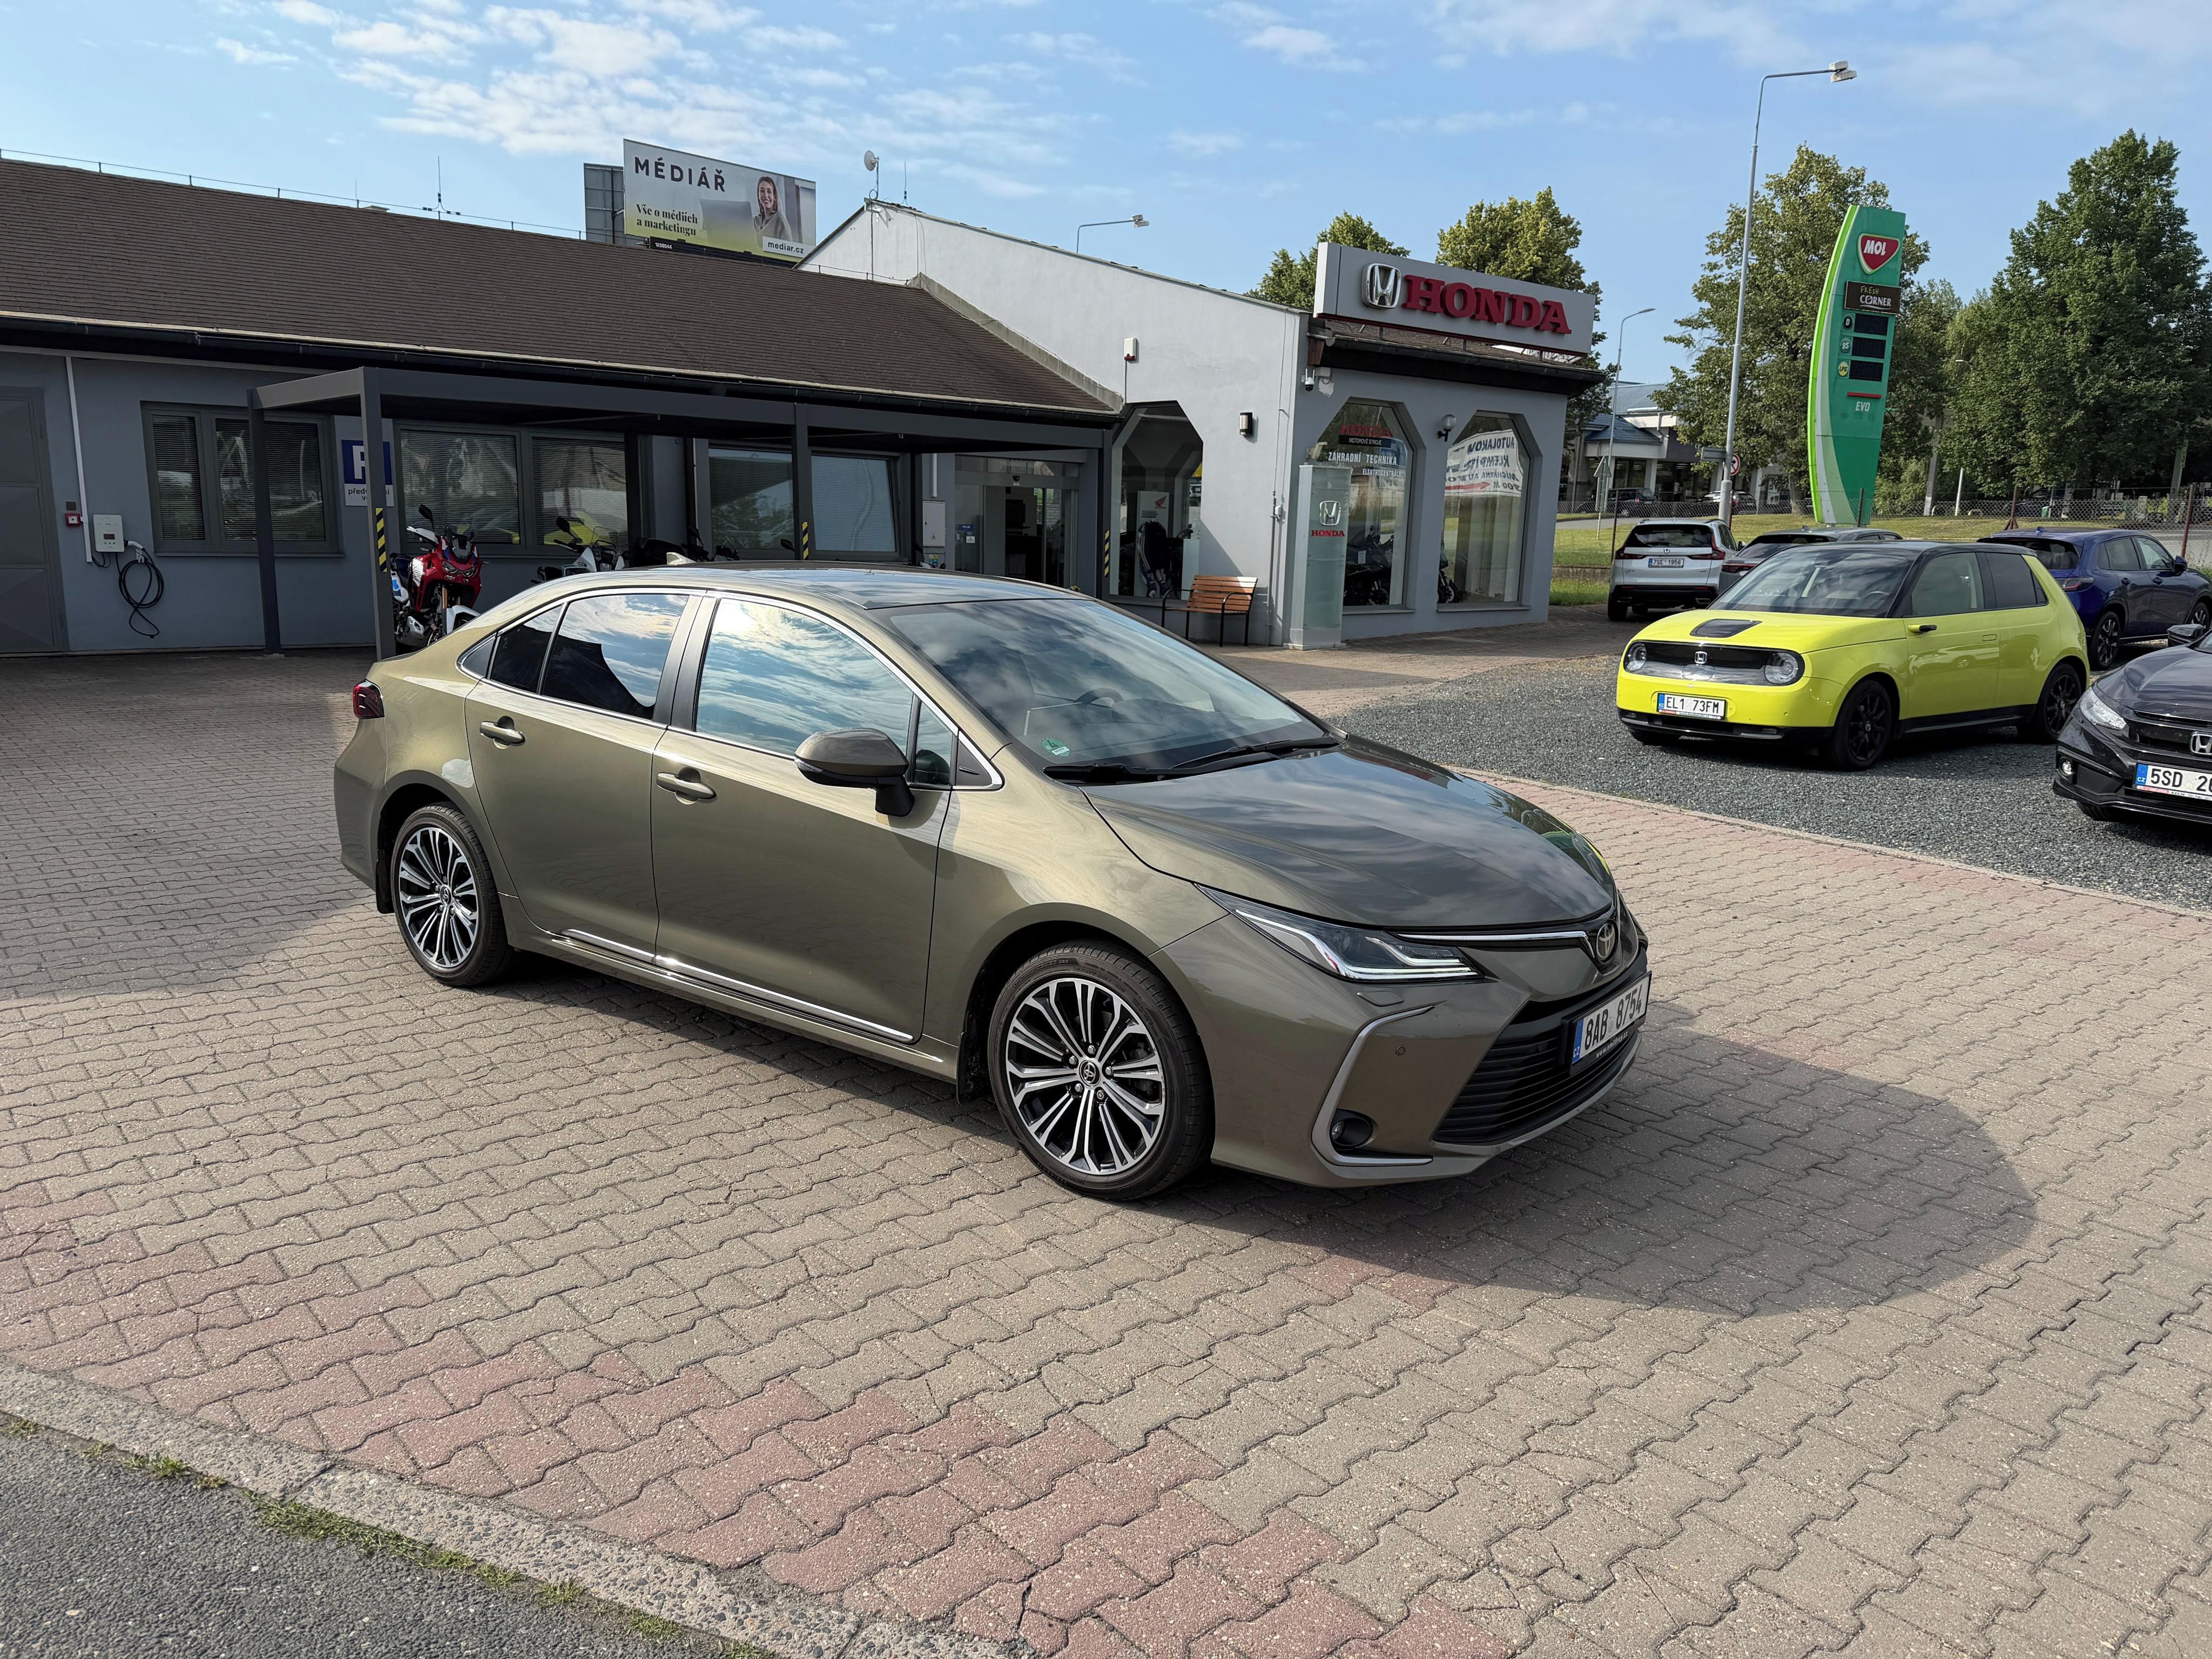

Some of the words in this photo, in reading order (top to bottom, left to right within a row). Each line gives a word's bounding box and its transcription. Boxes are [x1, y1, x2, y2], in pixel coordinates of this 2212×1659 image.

[635, 157, 725, 192] MÉDIÁŘ
[636, 204, 652, 215] Vše
[662, 210, 698, 224] médiích
[645, 220, 696, 237] marketingu
[767, 241, 805, 254] mediar.cz
[1864, 240, 1887, 255] MOL
[1860, 286, 1879, 295] FRESH
[1402, 274, 1572, 334] HONDA
[1860, 295, 1892, 306] CORNER
[1856, 401, 1870, 412] EVO
[1339, 423, 1392, 437] HONDA
[1328, 452, 1361, 463] ZAHRADNÍ
[1366, 454, 1397, 466] TECHNIKA
[1311, 529, 1345, 537] HONDA
[1667, 697, 1684, 710] EL1
[1692, 700, 1719, 714] 73FM
[2150, 768, 2183, 788] 5SD
[1584, 1008, 1609, 1050] 8AB
[1616, 984, 1642, 1029] 8754
[1573, 1047, 1580, 1057] CZ
